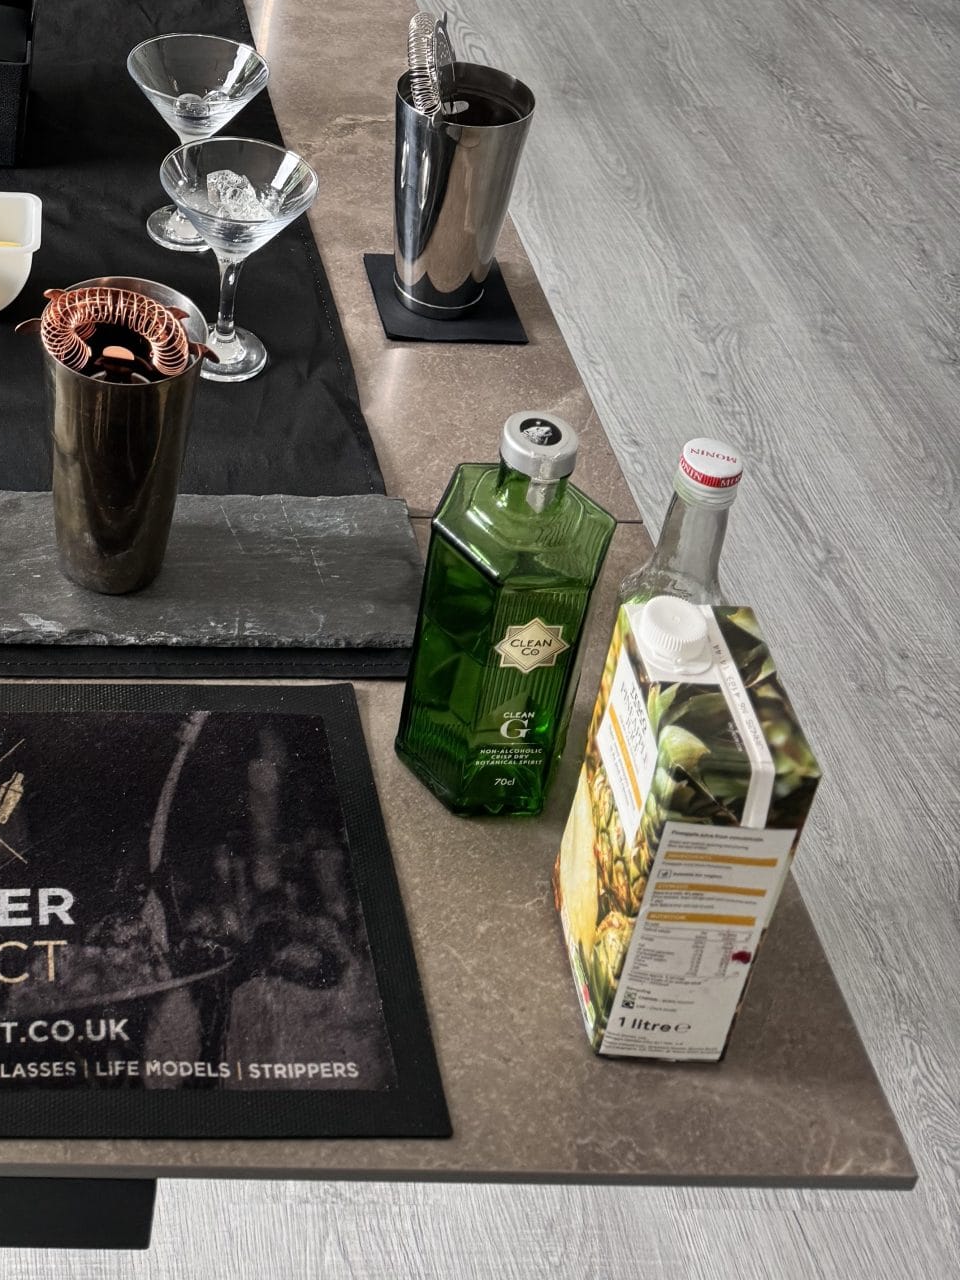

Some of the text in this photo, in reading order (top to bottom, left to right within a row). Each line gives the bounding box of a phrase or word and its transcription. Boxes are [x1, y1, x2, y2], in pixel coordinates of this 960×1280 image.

[690, 448, 737, 464] MONIN
[510, 638, 553, 648] CLEAN
[521, 647, 540, 656] CO
[503, 711, 536, 719] CLEAN
[500, 718, 532, 739] G
[494, 777, 516, 786] 70cl
[618, 1016, 672, 1033] 1 litre
[95, 1060, 140, 1077] LIFE
[145, 1059, 231, 1078] MODELS
[248, 1061, 359, 1080] STRIPPERS
